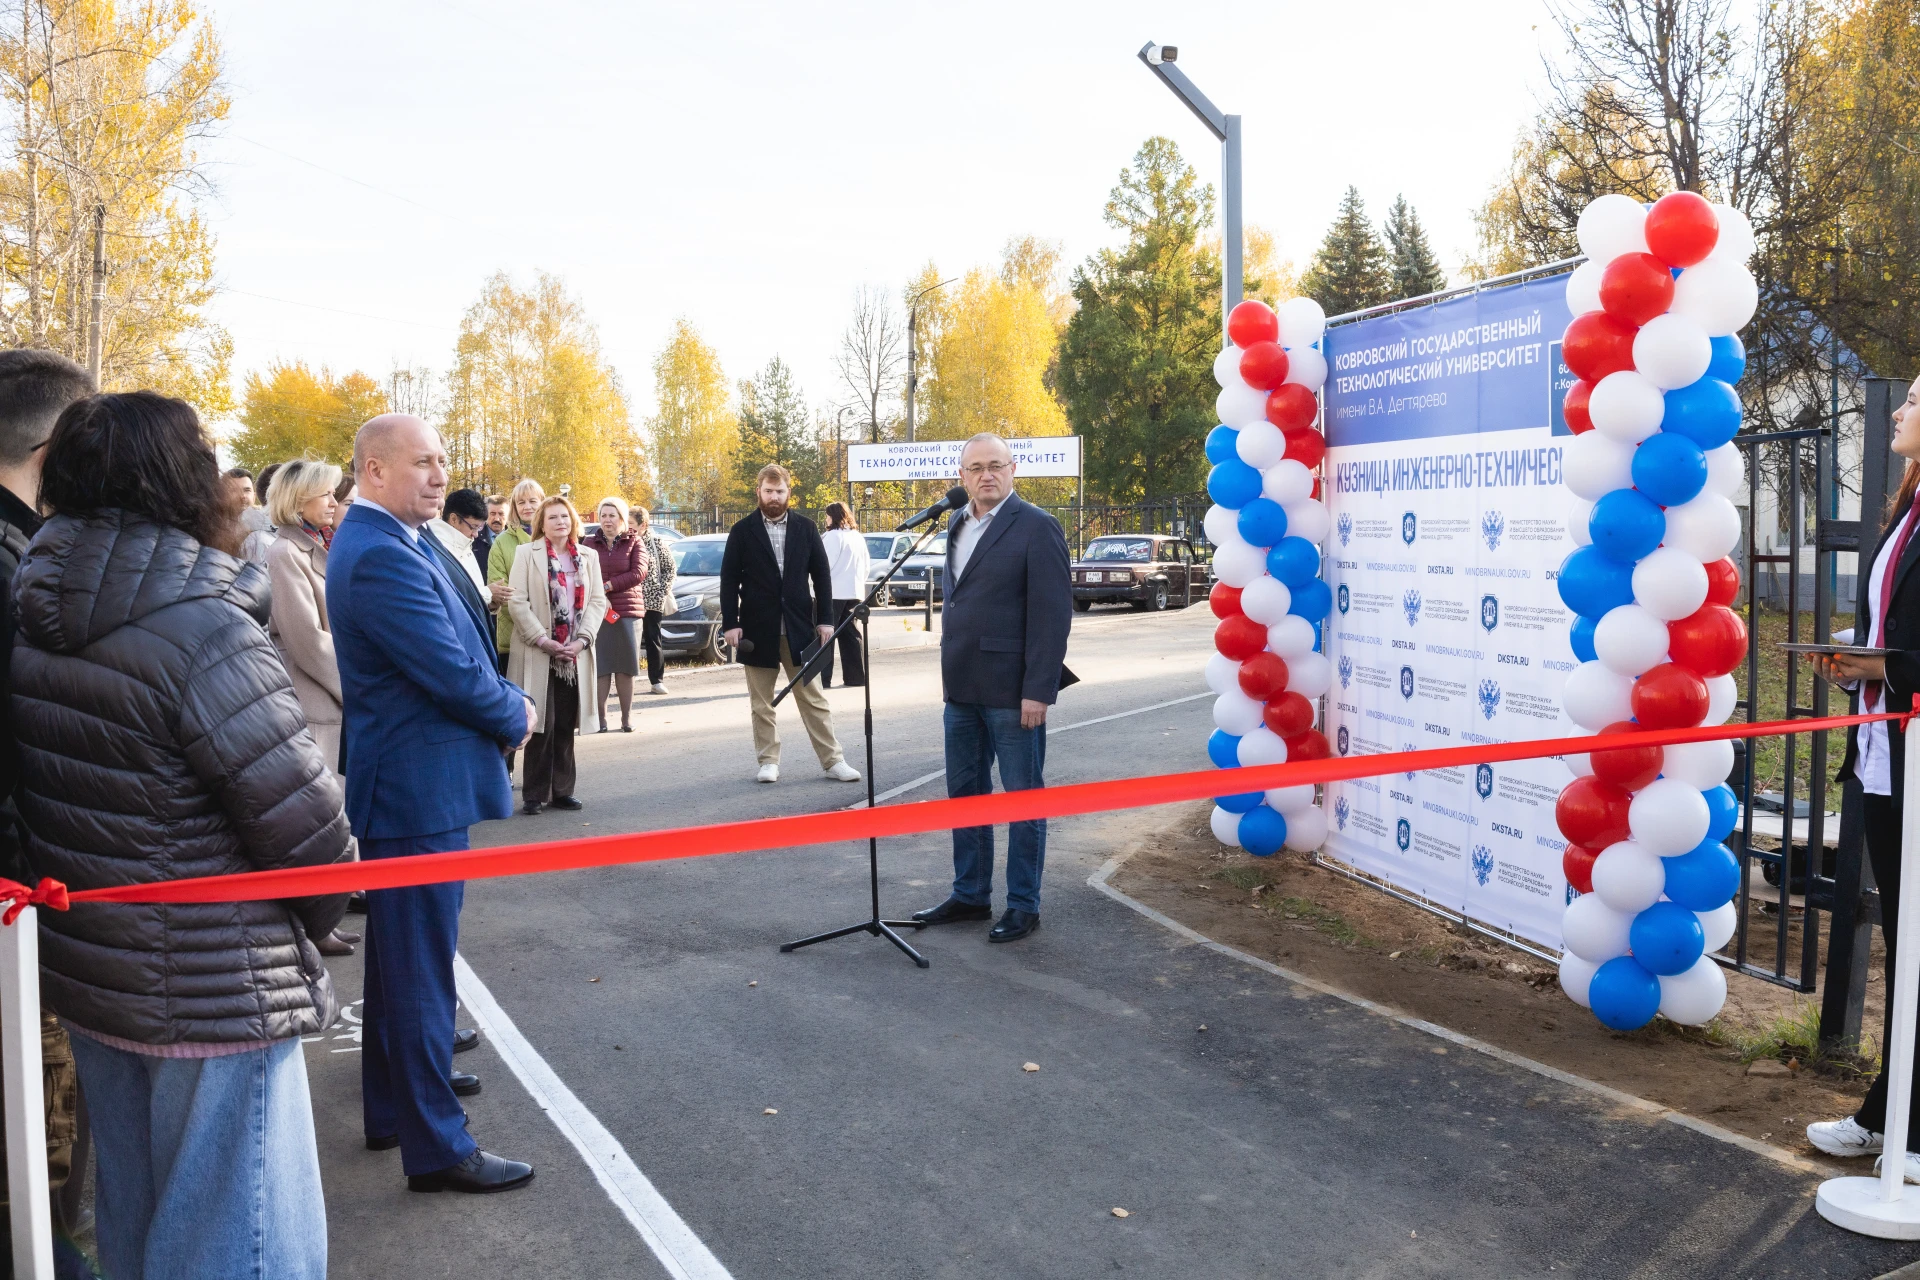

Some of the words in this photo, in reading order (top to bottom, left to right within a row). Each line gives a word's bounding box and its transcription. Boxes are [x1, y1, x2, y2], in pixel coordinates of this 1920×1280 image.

[1336, 337, 1407, 370] КОВРОВСКИЙ
[1412, 310, 1540, 357] ГОСУДАРСТВЕННЫЙ
[1336, 356, 1442, 394] ТЕХНОЛОГИЧЕСКИЙ
[1446, 343, 1542, 376] УНИВЕРСИТЕТ
[1336, 404, 1366, 419] имени
[1368, 398, 1386, 415] В.А.
[1388, 392, 1447, 415] Дегтярева
[888, 444, 940, 454] КОВРОВСКИЙ
[1336, 460, 1390, 499] КУЗНИЦА
[1337, 561, 1358, 570] DKSTA.RU
[1428, 565, 1453, 574] DKSTA.RU
[1465, 567, 1531, 579] MINOBRNAUKI.GOV.RU
[1392, 640, 1416, 650] DKSTA.RU
[1426, 644, 1484, 660] MINOBRNAUKI.GOV.RU
[1498, 653, 1529, 666] DKSTA.RU
[1337, 702, 1357, 714] DKSTA.RU
[1366, 709, 1414, 727] MINOBRNAUKI.GOV.RU
[1424, 722, 1450, 736] DKSTA.RU
[1390, 790, 1413, 804] DKSTA.RU
[1422, 800, 1479, 826] MINOBRNAUKI.GOV.RU
[1492, 822, 1522, 839] DKSTA.RU
